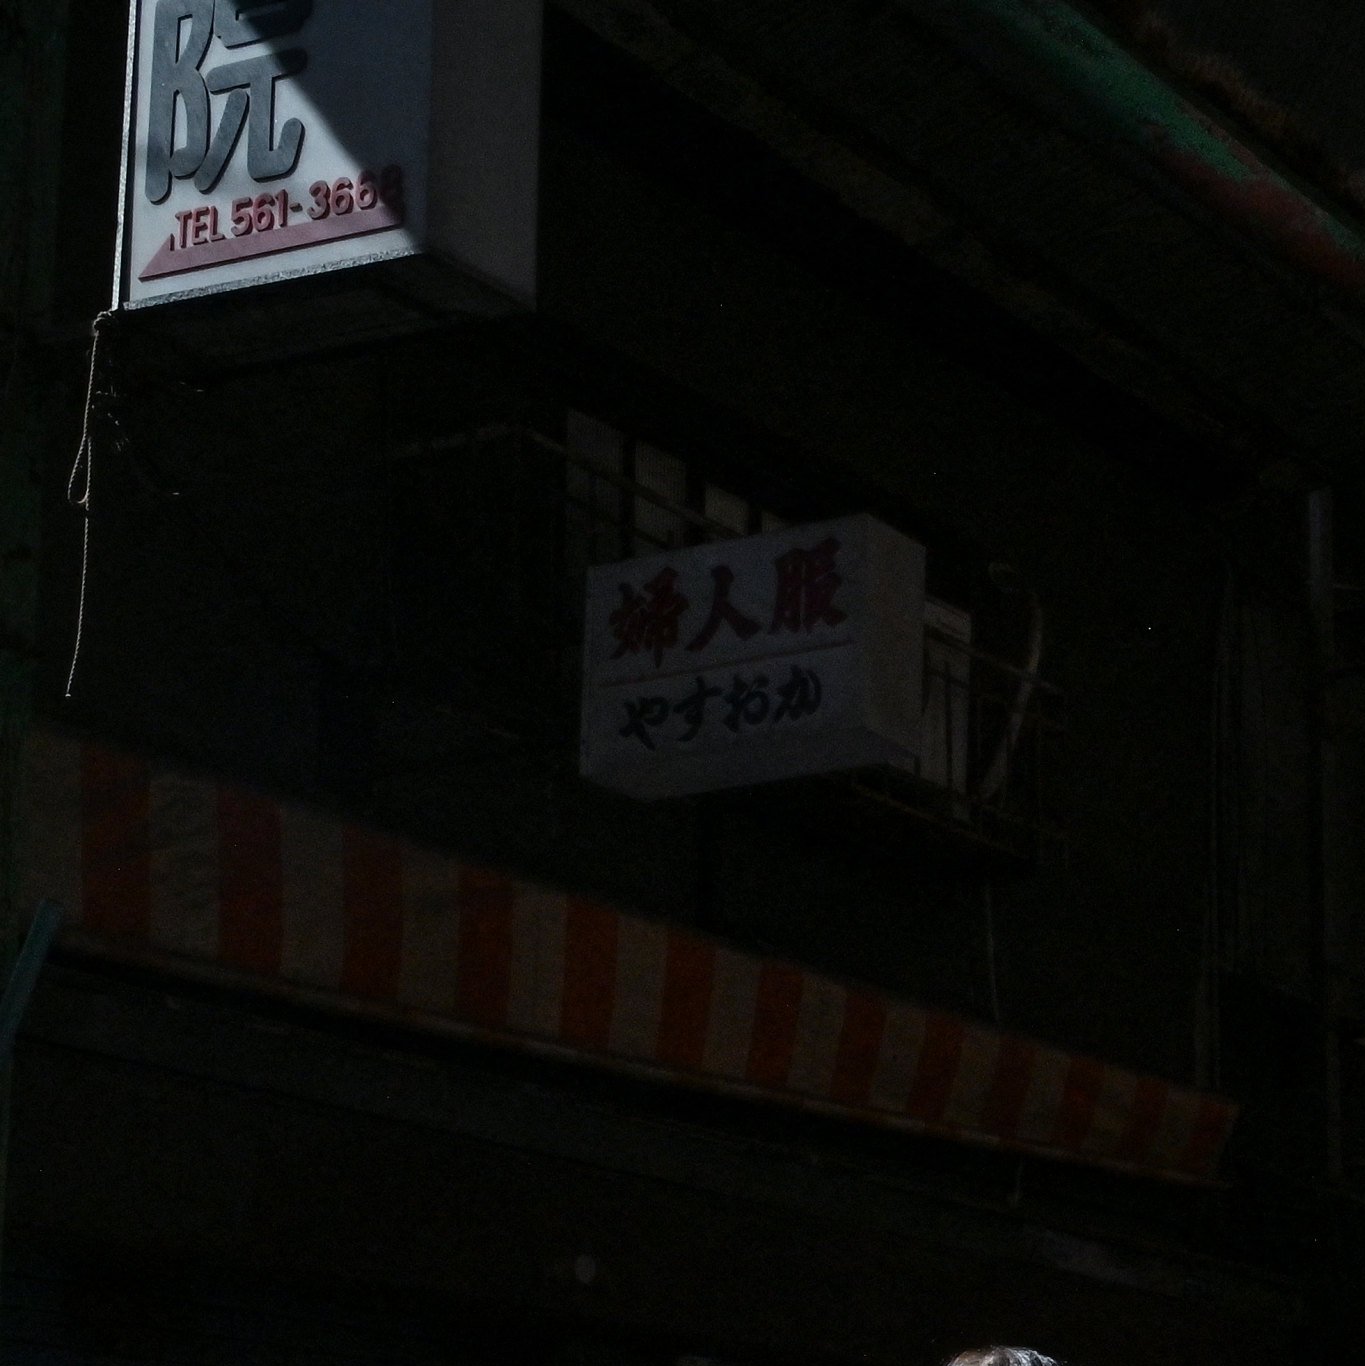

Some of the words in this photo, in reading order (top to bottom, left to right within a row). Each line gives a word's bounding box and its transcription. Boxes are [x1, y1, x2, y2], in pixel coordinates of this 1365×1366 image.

[174, 205, 226, 249] TEL
[608, 535, 848, 668] 婦人服
[618, 662, 824, 751] やすおか
